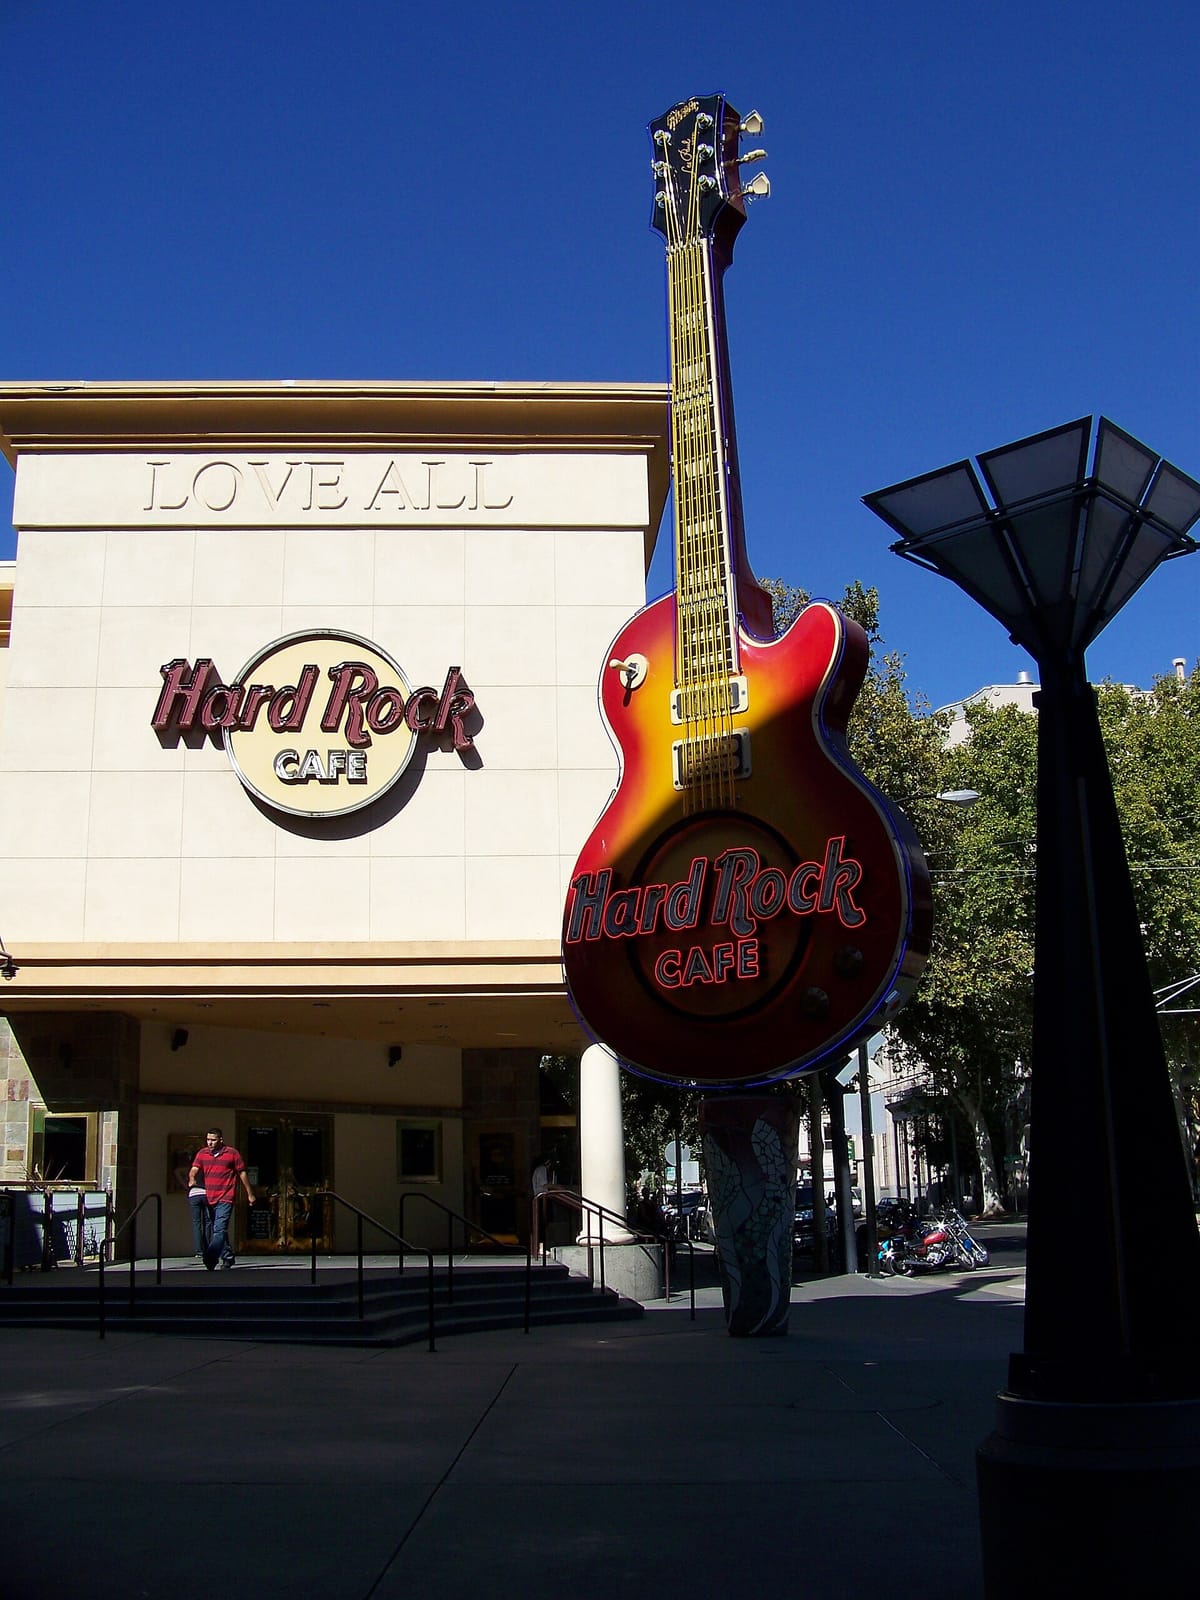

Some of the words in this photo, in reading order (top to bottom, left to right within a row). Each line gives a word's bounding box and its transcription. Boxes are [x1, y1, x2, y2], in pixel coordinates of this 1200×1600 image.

[143, 461, 348, 511] LOVE
[364, 460, 514, 511] ALL
[151, 658, 319, 733] Hard
[321, 661, 476, 751] Rock
[273, 748, 368, 785] CAFE
[566, 857, 707, 943] Hard
[711, 835, 867, 937] Rock
[655, 938, 759, 988] CAFE
